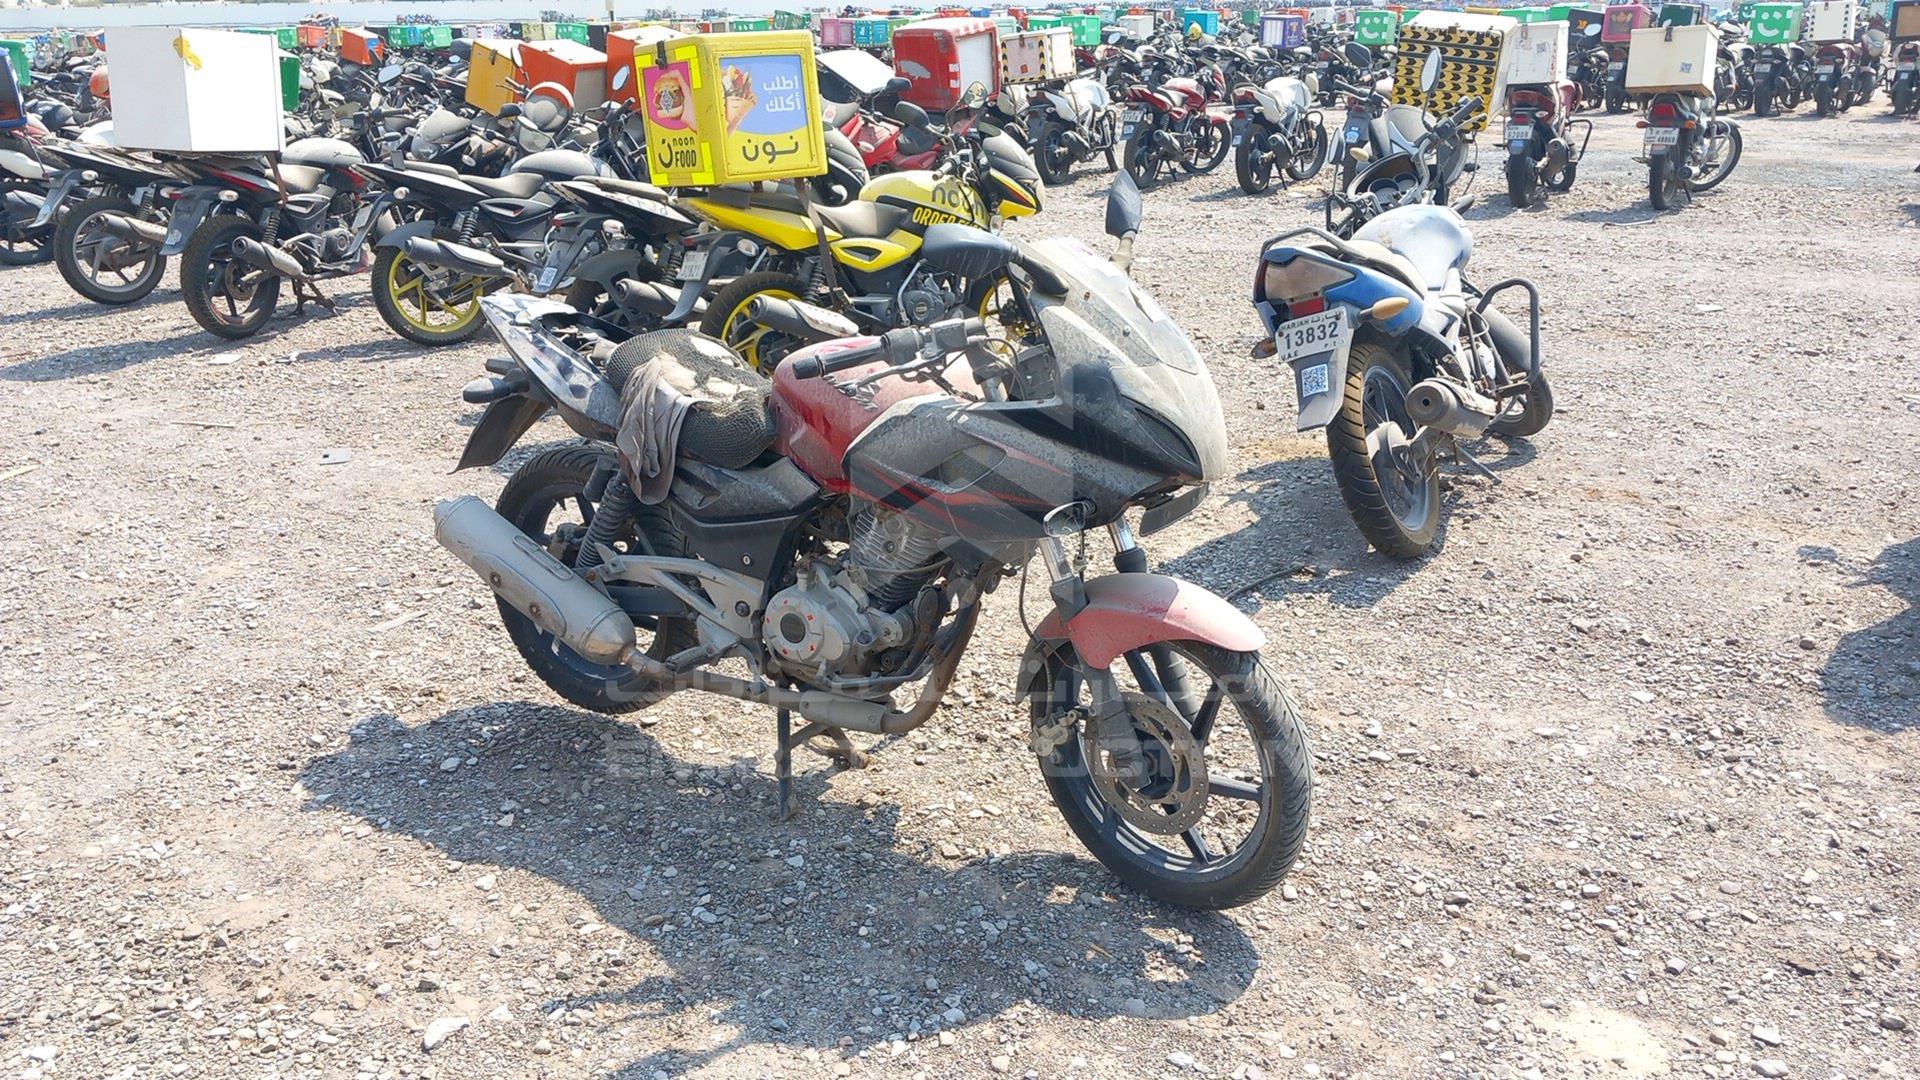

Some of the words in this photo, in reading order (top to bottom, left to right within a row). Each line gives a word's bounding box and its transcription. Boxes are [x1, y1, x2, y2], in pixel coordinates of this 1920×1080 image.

[763, 75, 799, 93] اطلب
[765, 93, 801, 113] أكلك
[672, 135, 695, 146] noon
[741, 135, 800, 165] نون
[674, 149, 697, 168] FOOD
[1284, 321, 1339, 350] 13832
